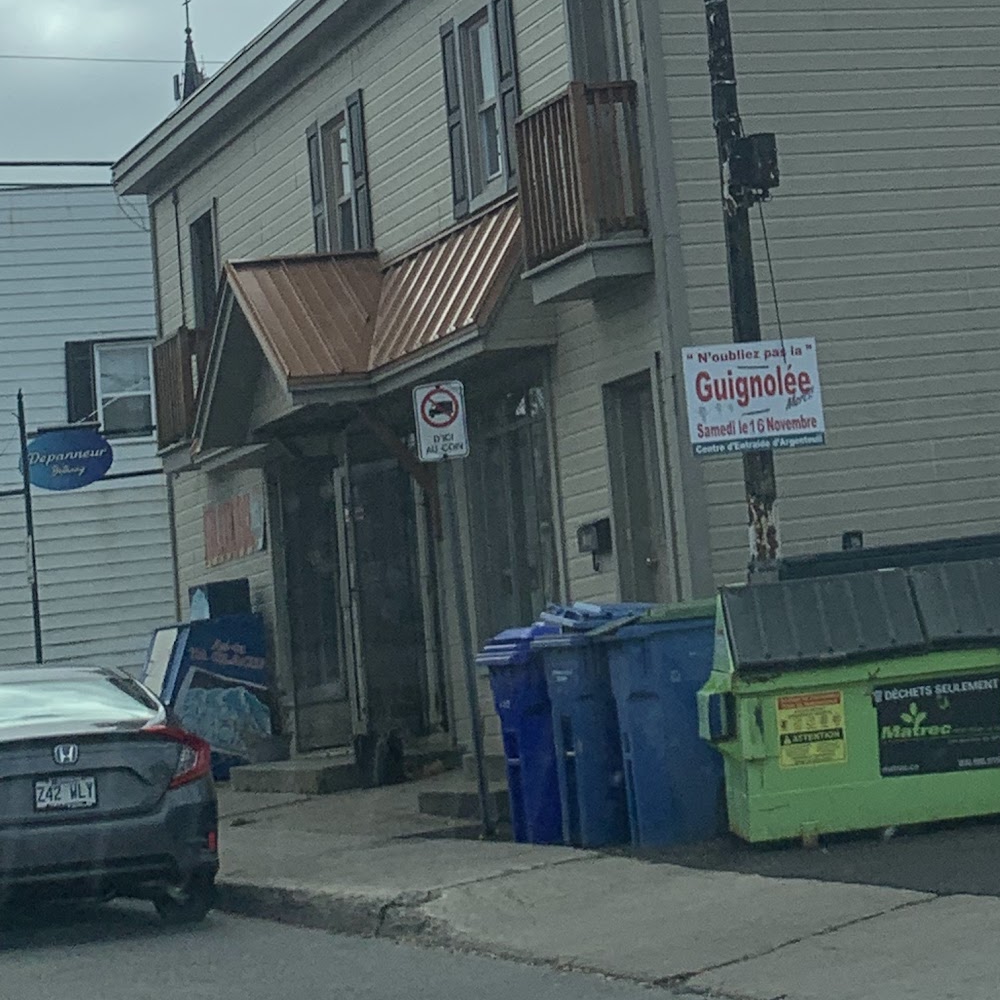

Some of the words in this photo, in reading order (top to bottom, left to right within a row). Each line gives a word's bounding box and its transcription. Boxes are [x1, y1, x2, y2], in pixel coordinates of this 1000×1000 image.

[698, 348, 759, 363] N'oubliez
[764, 347, 786, 361] pas
[790, 345, 802, 356] la
[695, 364, 811, 407] Guignolée
[697, 421, 736, 439] Samedi
[738, 420, 749, 434] le
[750, 418, 765, 434] 16
[767, 415, 817, 431] Novembre
[426, 445, 438, 455] AU
[696, 443, 725, 454] Centre
[934, 678, 999, 695] SEULEMENT
[881, 724, 952, 739] Matrec
